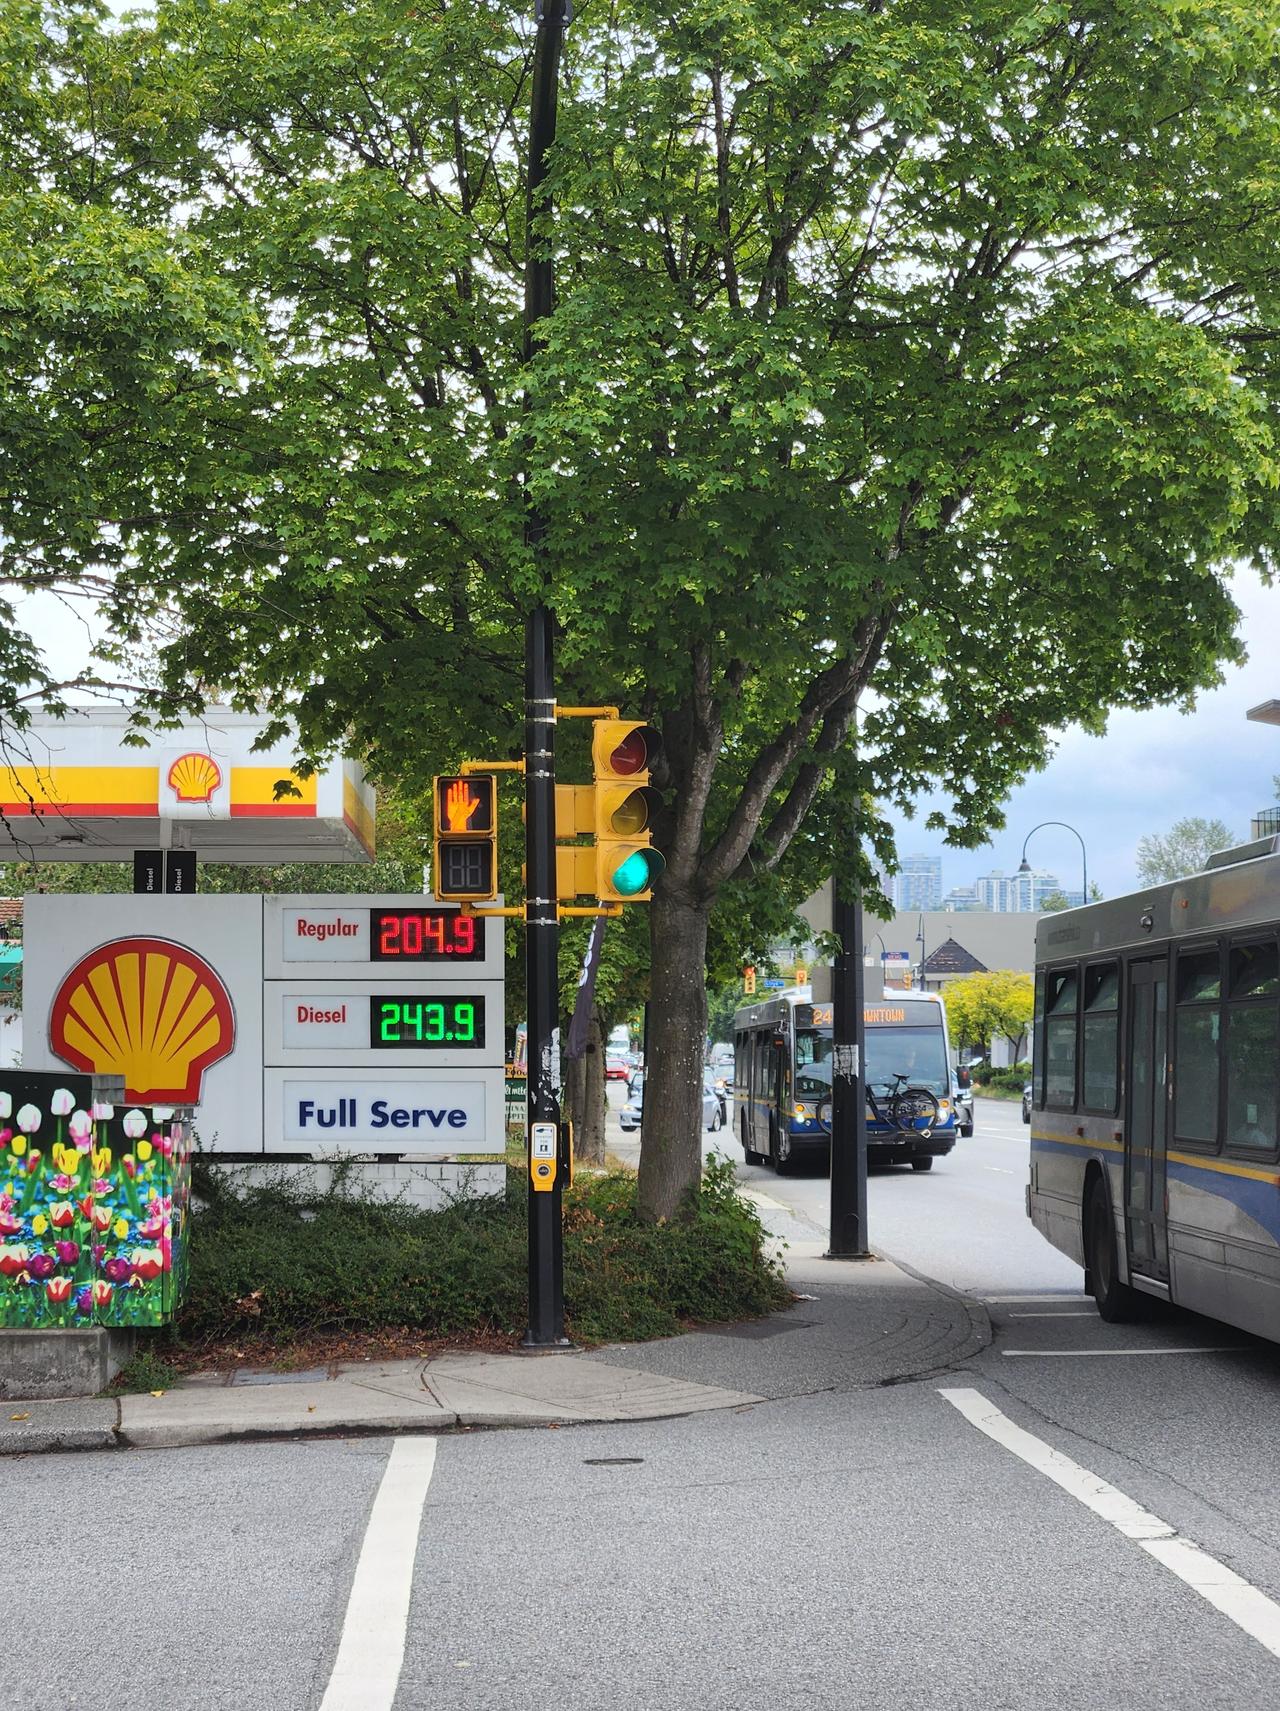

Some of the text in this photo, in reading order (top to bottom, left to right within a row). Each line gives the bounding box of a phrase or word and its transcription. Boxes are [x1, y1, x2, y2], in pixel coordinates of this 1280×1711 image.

[146, 867, 154, 891] Diesel
[174, 868, 182, 892] Diesel
[297, 918, 359, 941] Regular
[380, 916, 474, 954] 204.9
[297, 1005, 347, 1024] Diesel
[380, 1003, 474, 1041] 243.9
[299, 1099, 467, 1128] Full Serve
